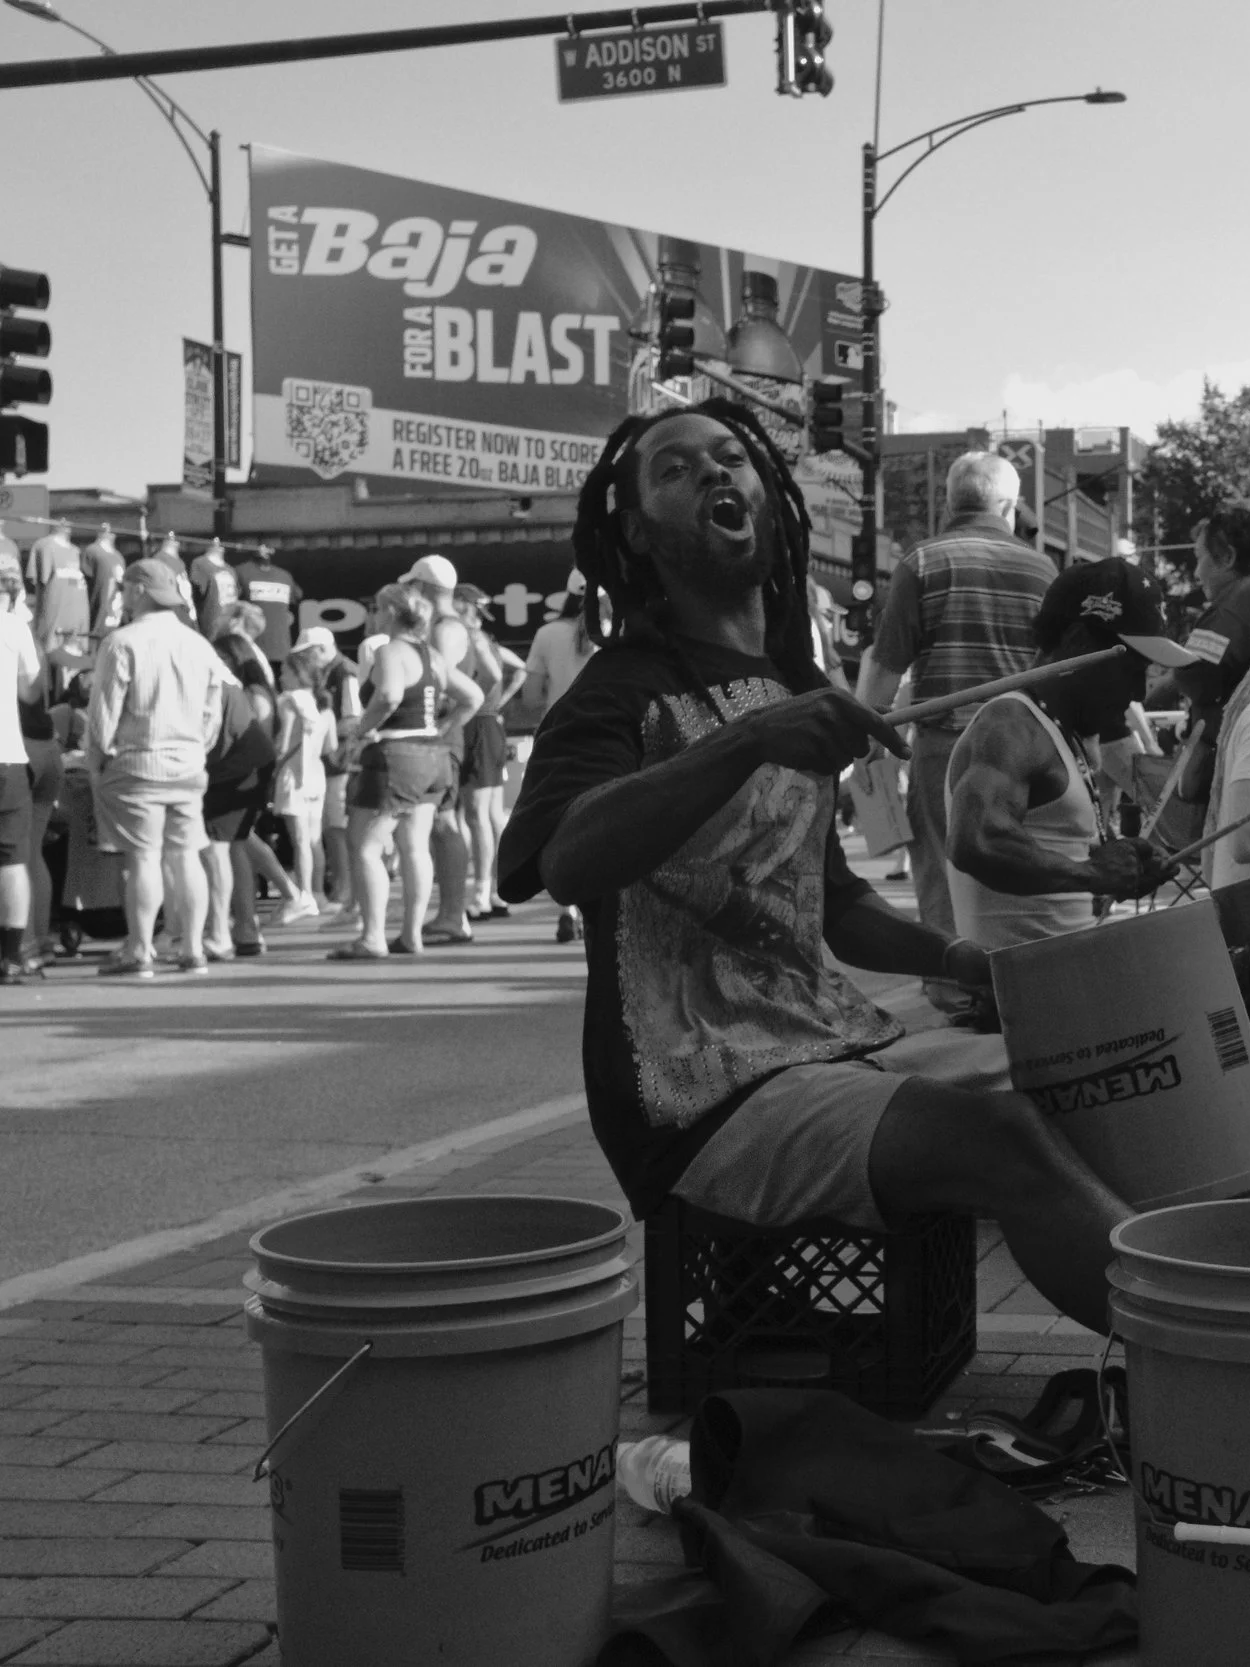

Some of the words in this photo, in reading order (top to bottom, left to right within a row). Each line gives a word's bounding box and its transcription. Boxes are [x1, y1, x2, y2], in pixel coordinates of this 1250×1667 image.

[563, 50, 577, 67] W
[585, 33, 690, 69] ADDISON
[695, 33, 717, 53] ST
[602, 67, 657, 89] 3600
[668, 64, 682, 82] N
[267, 205, 299, 224] A
[268, 226, 300, 275] GET
[300, 207, 538, 299] Baja
[403, 305, 433, 322] A
[403, 328, 433, 378] FOR
[434, 306, 621, 385] BLAST
[392, 419, 476, 451] REGISTER
[481, 431, 520, 457] NOW
[524, 436, 545, 459] TO
[550, 440, 599, 465] SCORE
[392, 448, 404, 471] A
[409, 451, 453, 476] FREE
[499, 461, 540, 487] BAJA
[545, 466, 588, 488] BLAS
[1076, 1048, 1092, 1060] to
[1095, 1028, 1165, 1057] Dedicated
[474, 1436, 616, 1525] MENA
[480, 1525, 570, 1563] Dedicated
[573, 1519, 588, 1538] to
[1210, 1551, 1229, 1569] to
